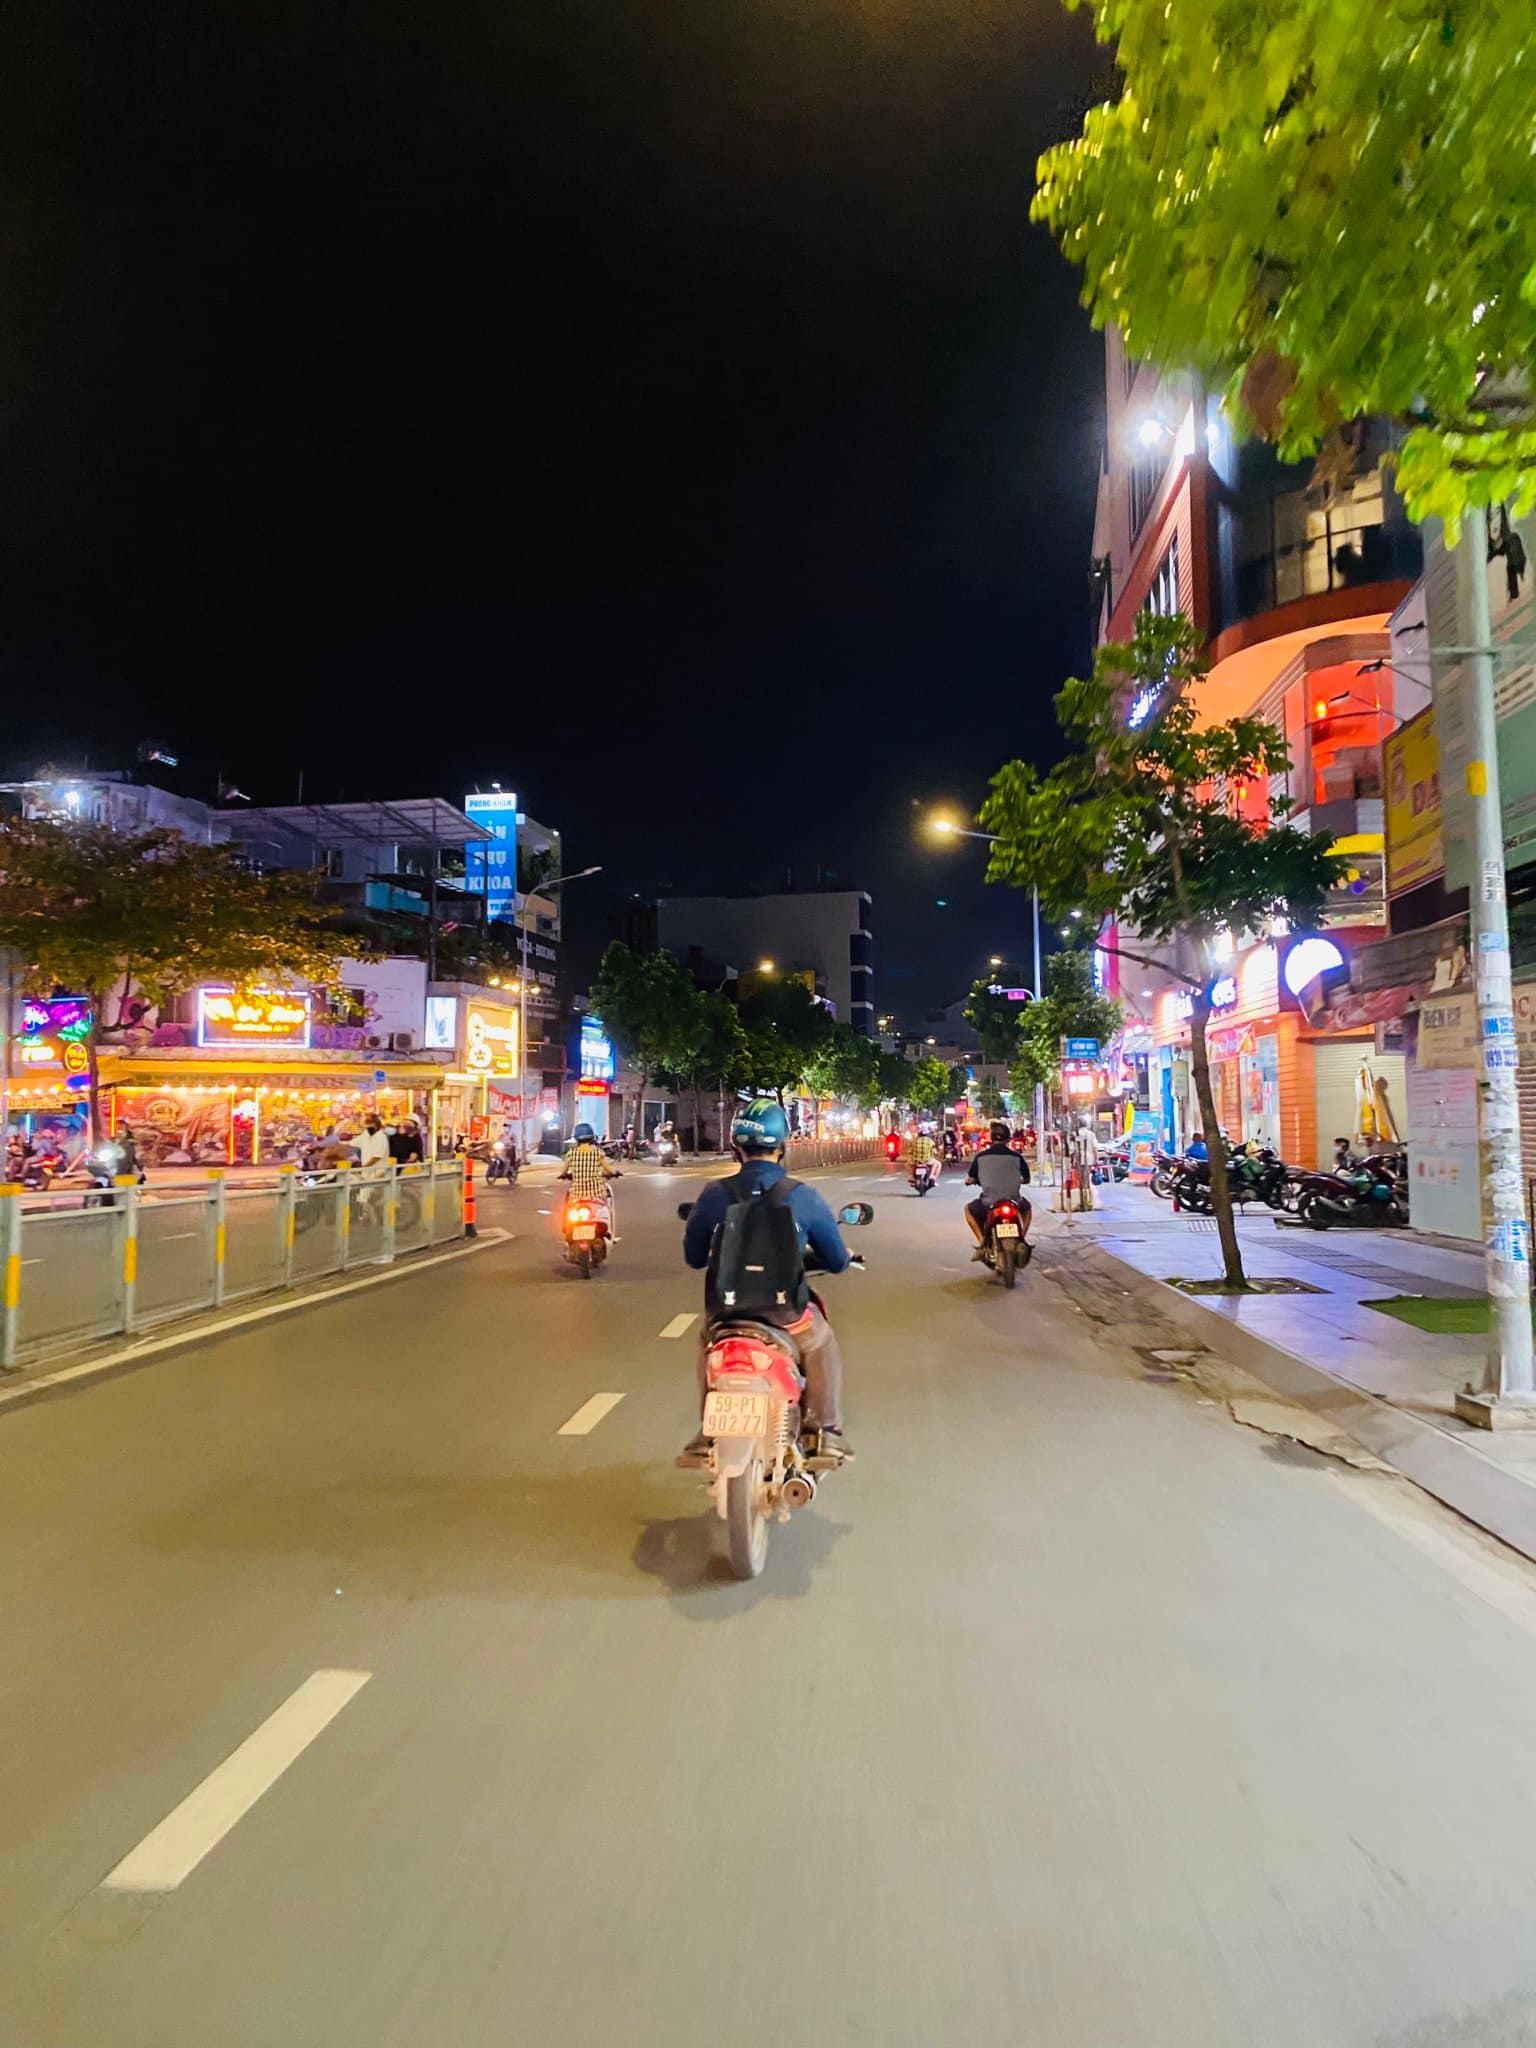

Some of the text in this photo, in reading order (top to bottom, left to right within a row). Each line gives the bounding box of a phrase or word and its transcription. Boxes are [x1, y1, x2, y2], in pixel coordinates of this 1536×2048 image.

[468, 875, 513, 891] KHOA
[715, 1395, 756, 1413] 59-P1
[708, 1414, 762, 1433] 90277
